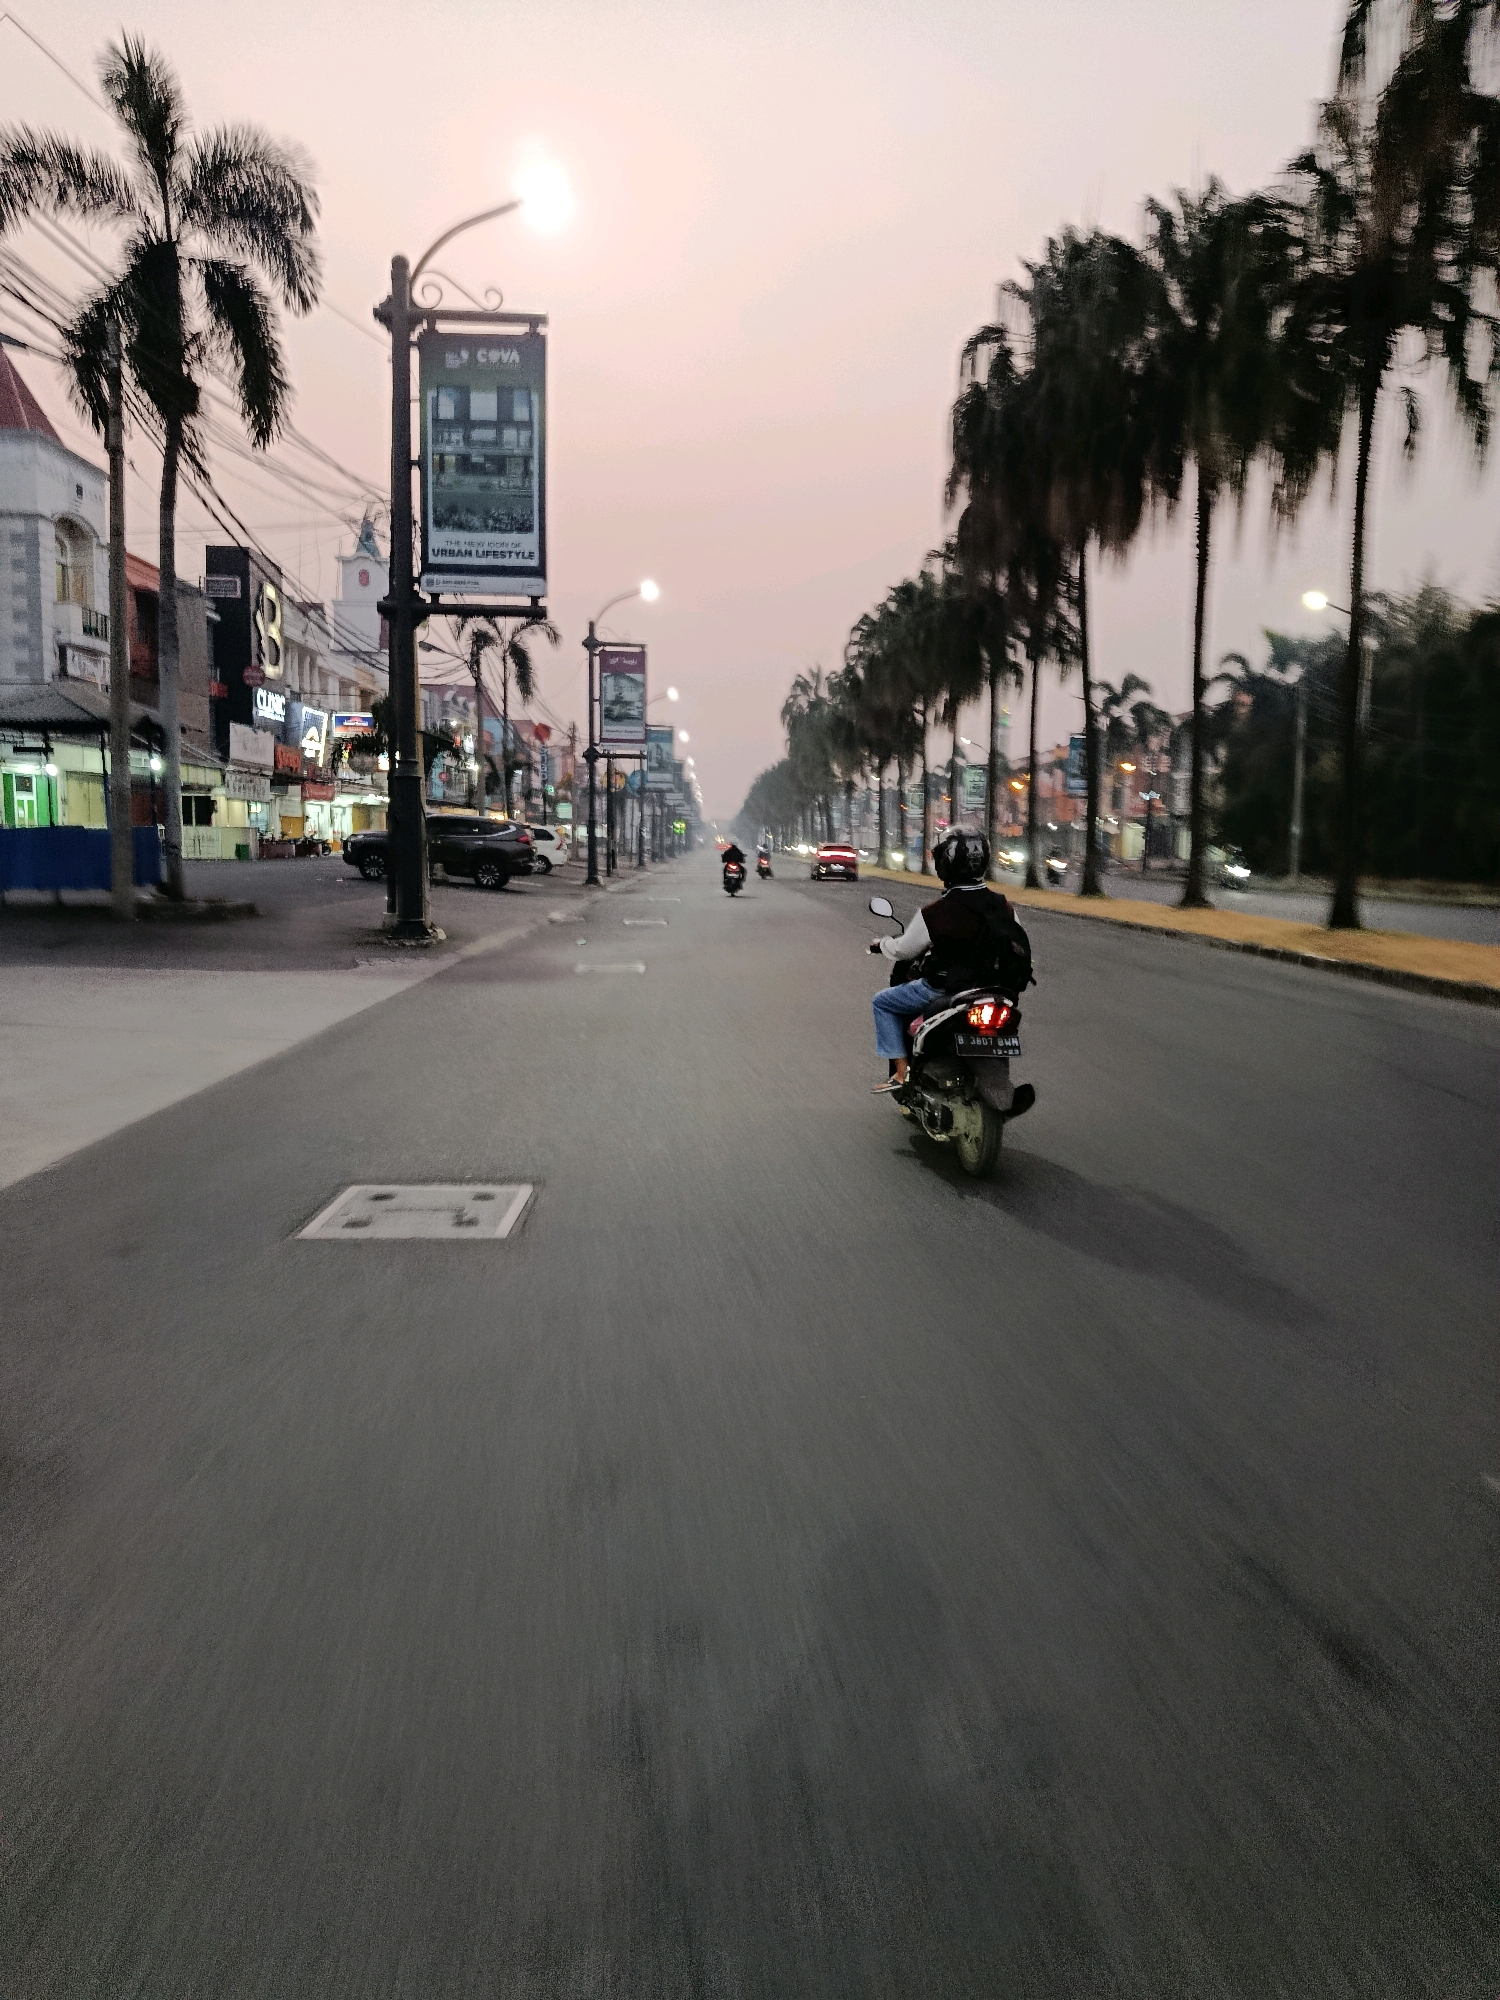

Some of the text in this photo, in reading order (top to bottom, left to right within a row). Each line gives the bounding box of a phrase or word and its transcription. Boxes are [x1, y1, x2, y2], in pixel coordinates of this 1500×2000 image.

[431, 548, 535, 560] URBAN LIFESTYLE
[957, 1035, 964, 1044] B
